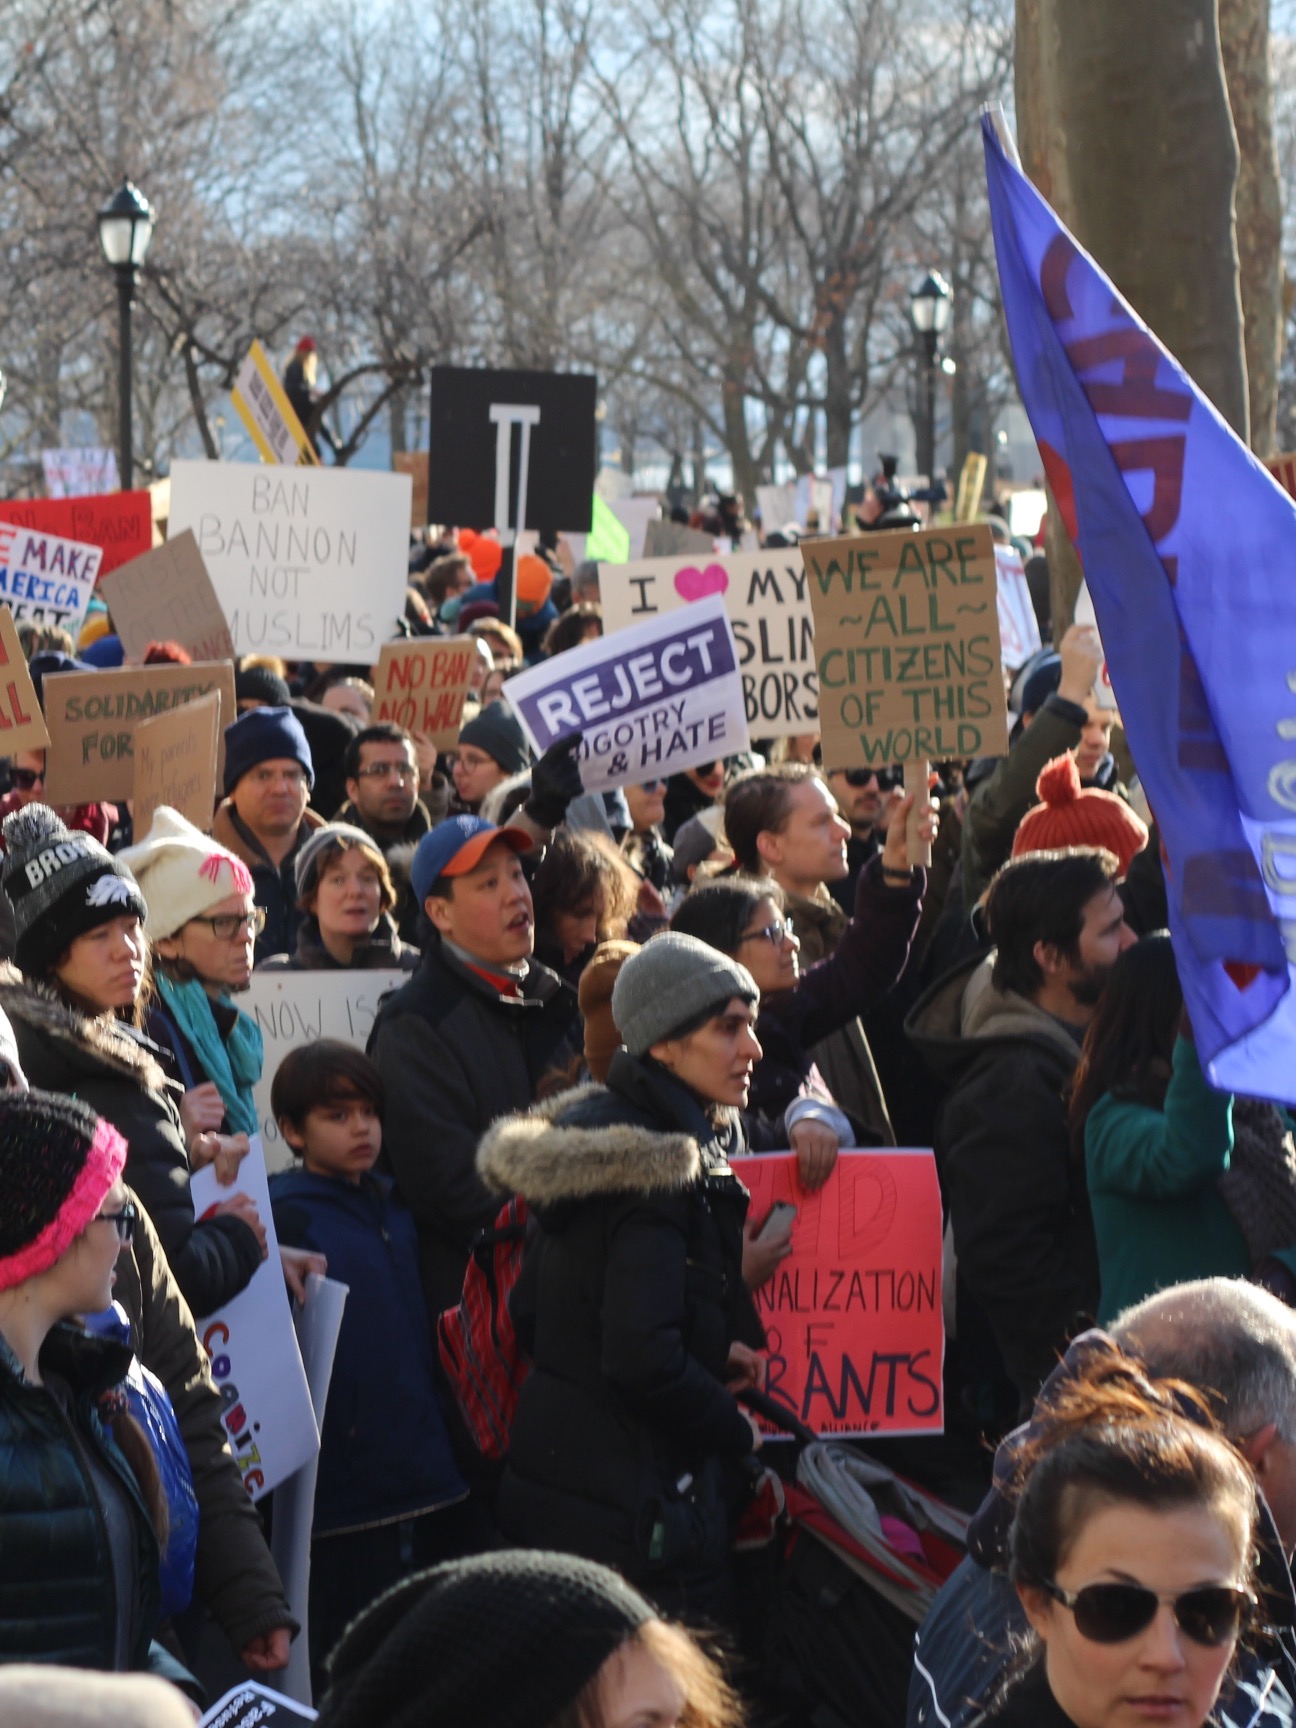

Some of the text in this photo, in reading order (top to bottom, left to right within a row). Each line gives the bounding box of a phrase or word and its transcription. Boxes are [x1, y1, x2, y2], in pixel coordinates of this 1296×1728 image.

[252, 474, 310, 518] BAN
[21, 536, 98, 584] MAKE
[198, 513, 357, 566] BANNON
[249, 564, 312, 599] NOT
[811, 537, 984, 597] WE ARE
[629, 575, 659, 614] I
[386, 649, 471, 694] NO BAN
[536, 629, 715, 737] REJECT
[818, 635, 994, 688] CITIZENS
[379, 691, 465, 733] NO WALL
[840, 681, 993, 729] OF THIS
[607, 710, 728, 778] & HATE
[859, 722, 983, 765] WORLD
[253, 993, 377, 1044] NOW IS
